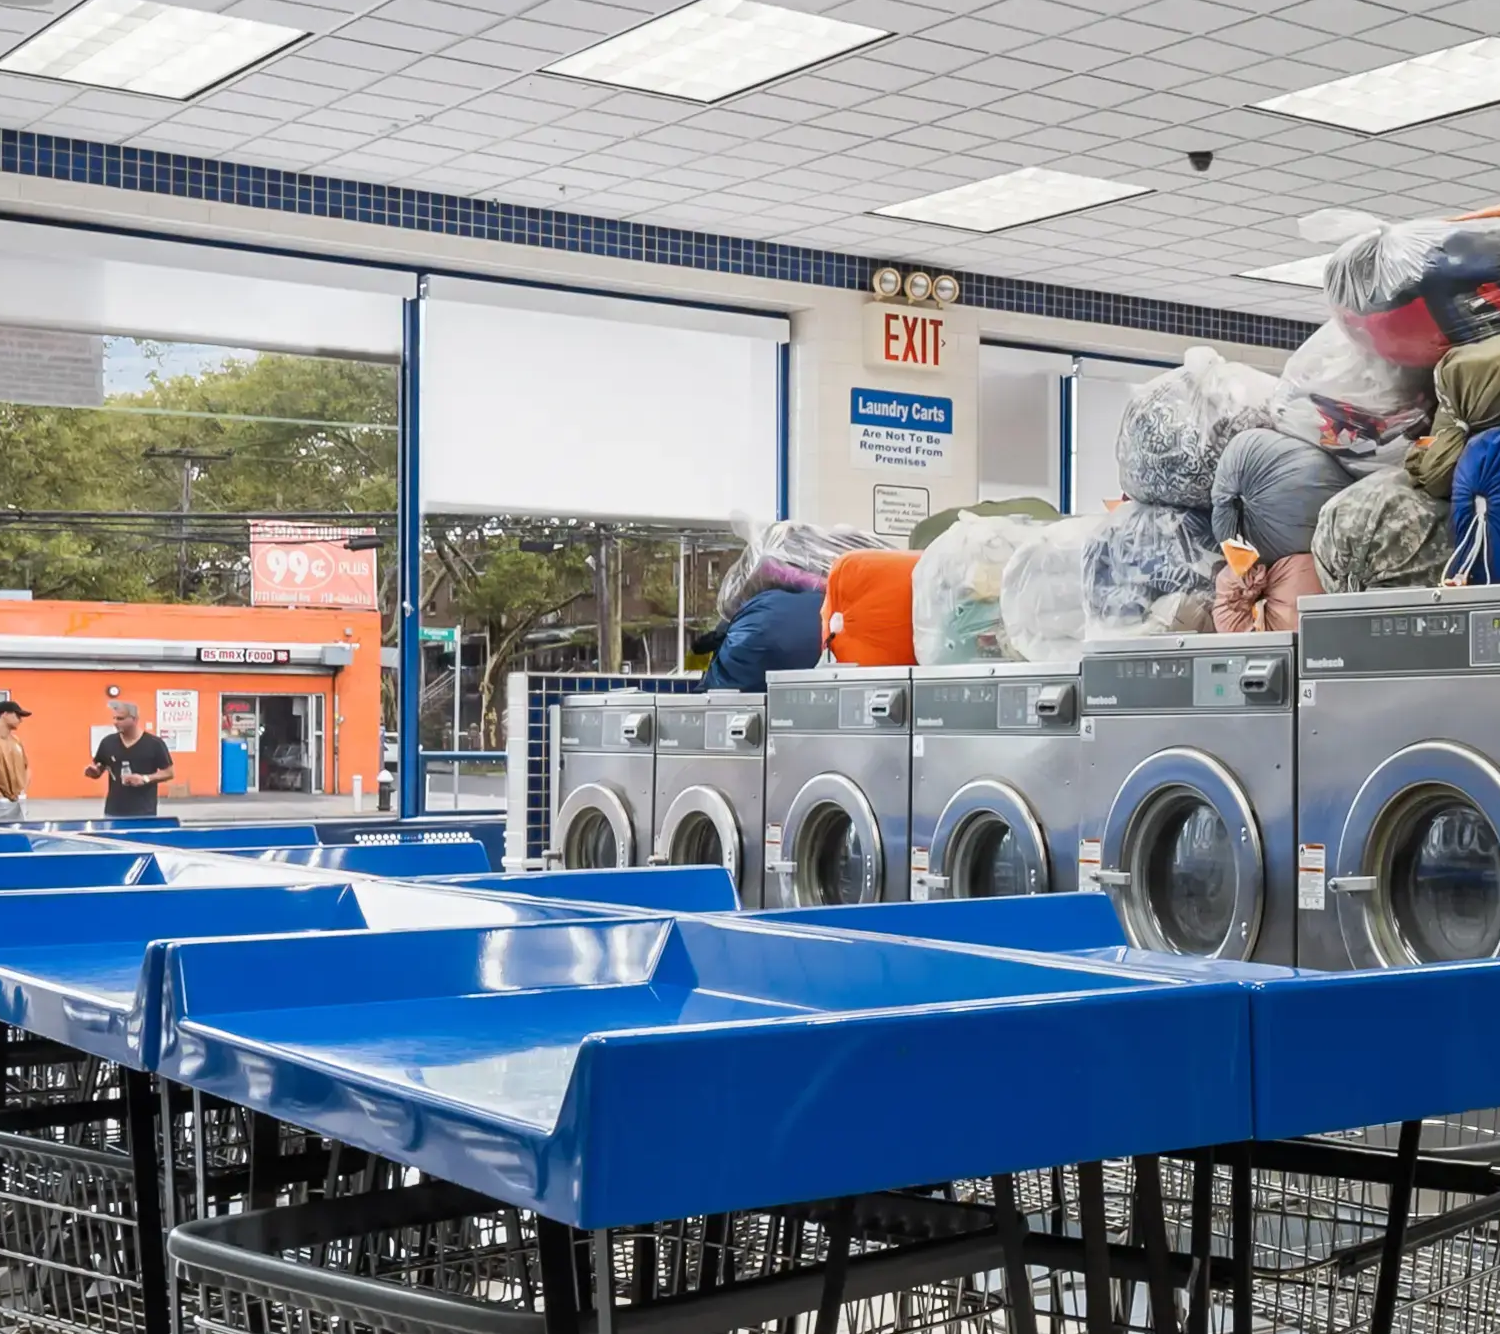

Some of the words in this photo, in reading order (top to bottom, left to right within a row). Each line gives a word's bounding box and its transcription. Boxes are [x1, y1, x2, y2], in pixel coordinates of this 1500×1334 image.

[884, 313, 944, 366] EXIT
[858, 396, 910, 423] Laundry
[912, 402, 945, 423] Carts
[862, 428, 882, 440] Are
[885, 431, 905, 442] Not
[909, 433, 923, 444] To
[926, 435, 941, 446] Be
[859, 441, 912, 455] Removed
[915, 445, 943, 458] From
[875, 453, 927, 468] Premises
[338, 561, 370, 576] PLUS
[218, 650, 242, 660] MAX
[248, 650, 273, 661] FOOD
[1303, 687, 1313, 699] 43
[163, 700, 190, 708] WIC
